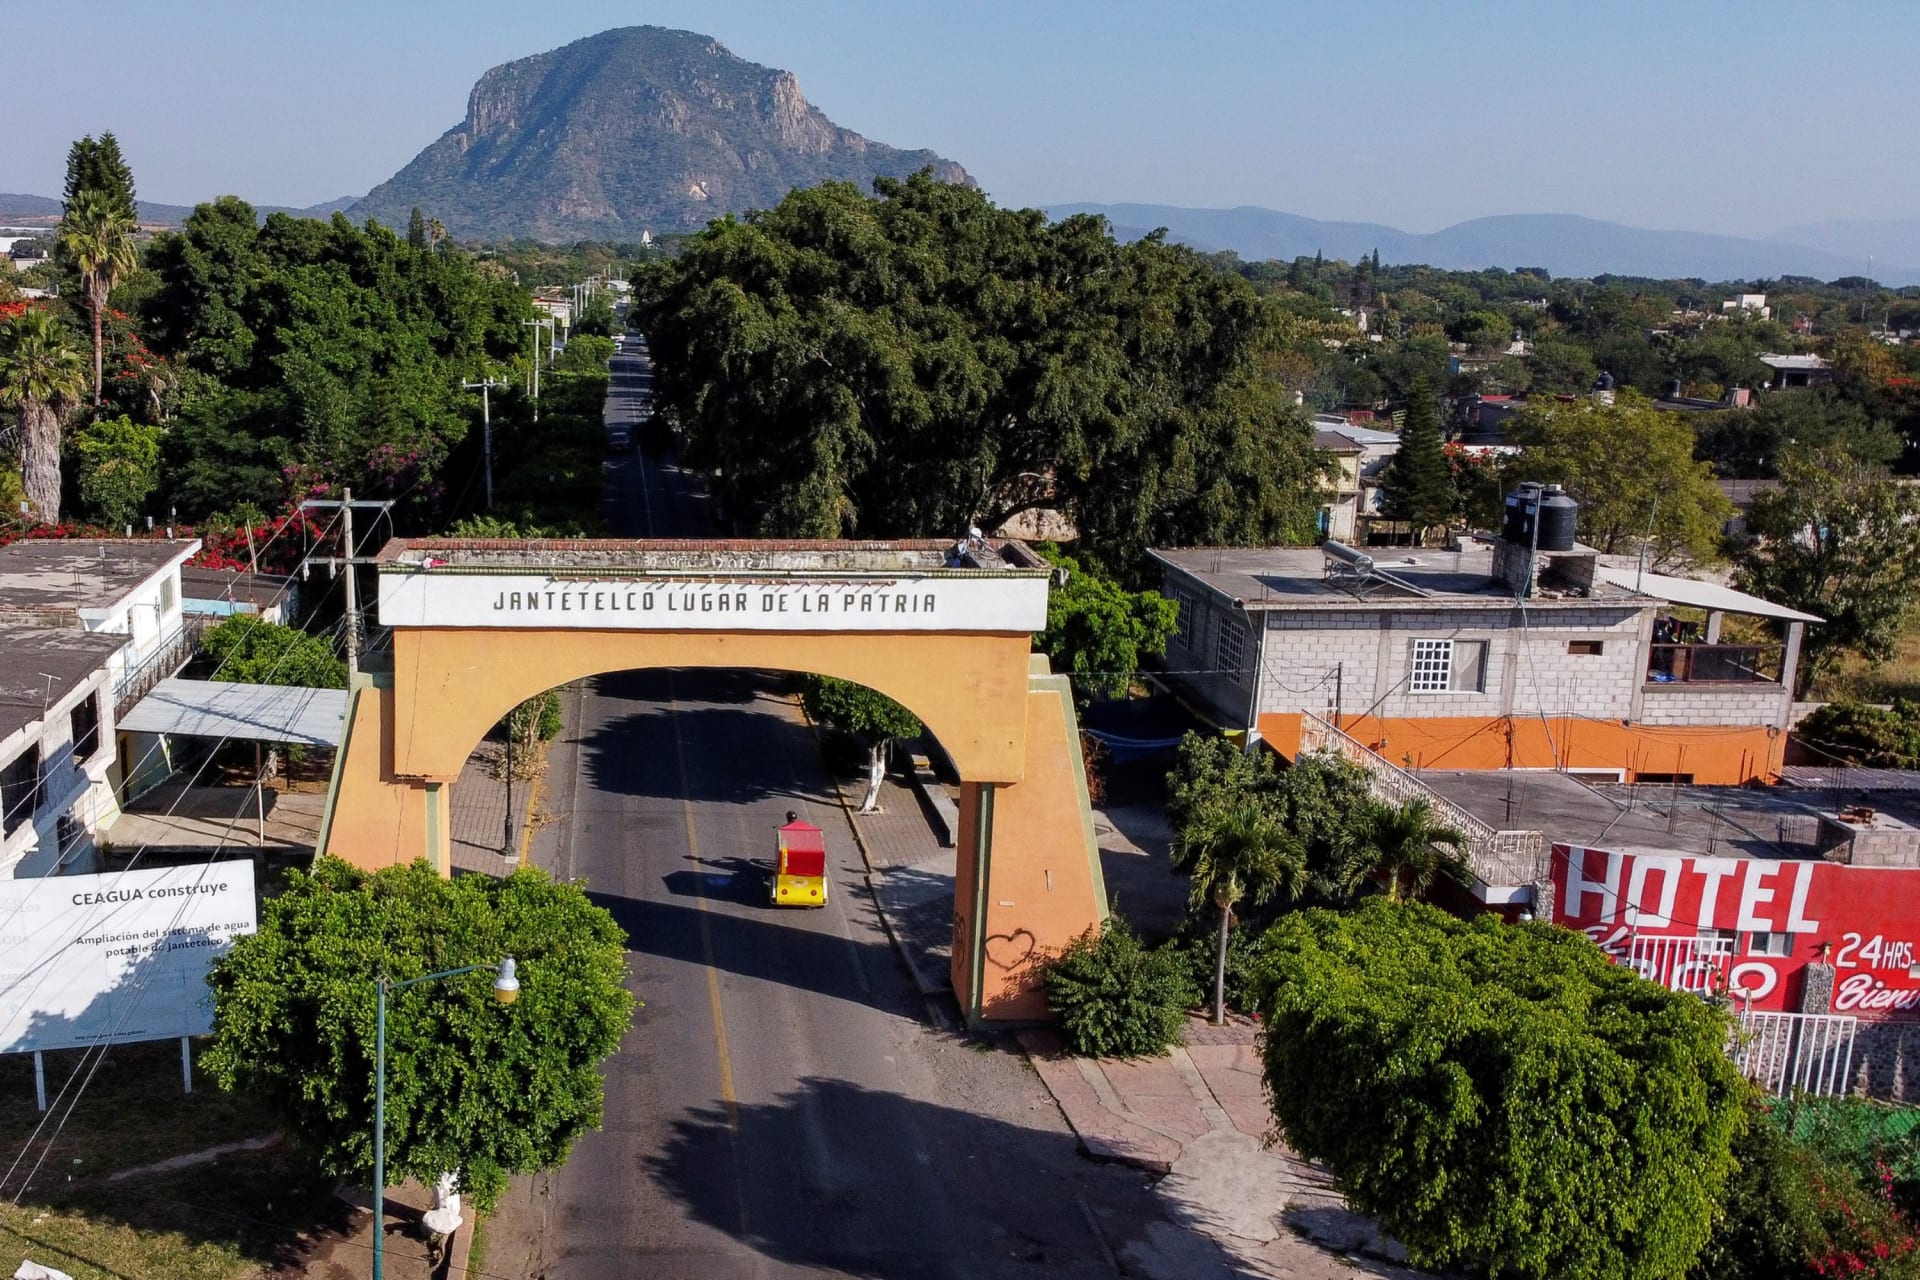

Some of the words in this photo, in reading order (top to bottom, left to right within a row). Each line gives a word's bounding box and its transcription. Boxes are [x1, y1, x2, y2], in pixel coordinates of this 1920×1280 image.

[493, 591, 655, 611] JANTETELCO
[668, 592, 748, 612] LUGAR
[762, 593, 788, 612] DE
[802, 593, 829, 613] LA
[843, 593, 936, 613] PATRIA
[72, 888, 143, 906] CEAGUA
[148, 881, 228, 900] construye
[1564, 847, 1820, 934] HOTEL
[76, 930, 139, 946] Ampliación
[142, 929, 159, 939] del
[162, 924, 206, 937] sistema
[208, 923, 221, 932] de
[224, 920, 250, 932] agua
[106, 944, 149, 959] potable
